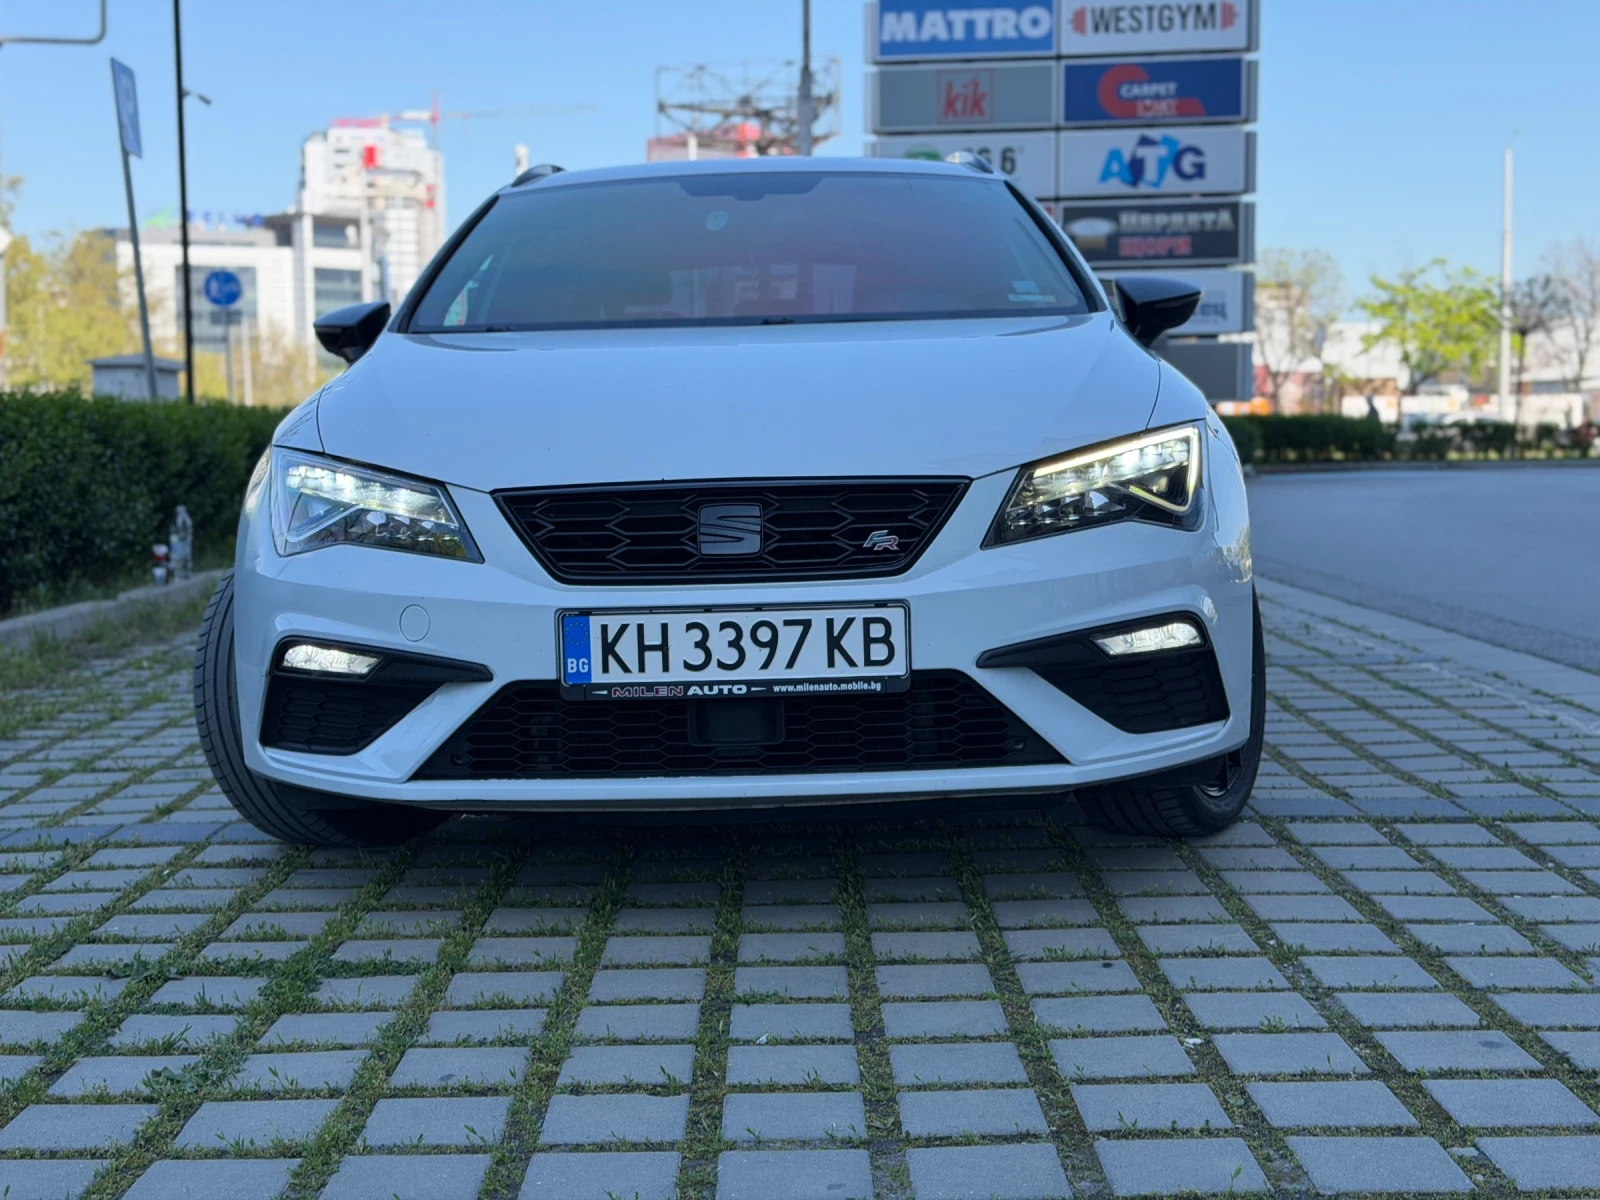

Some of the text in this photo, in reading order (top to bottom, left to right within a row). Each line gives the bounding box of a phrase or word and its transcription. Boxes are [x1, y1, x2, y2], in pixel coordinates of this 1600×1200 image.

[881, 6, 1052, 43] MATTRO
[1091, 2, 1217, 35] WESTGYM
[942, 74, 988, 119] kik
[1098, 142, 1206, 186] ATG
[862, 529, 900, 551] FR
[600, 617, 896, 674] KH 3397 KB
[567, 658, 589, 674] BG
[611, 684, 747, 698] MILEN AUTO
[773, 681, 882, 693] www.milenauto.mobile.bg
